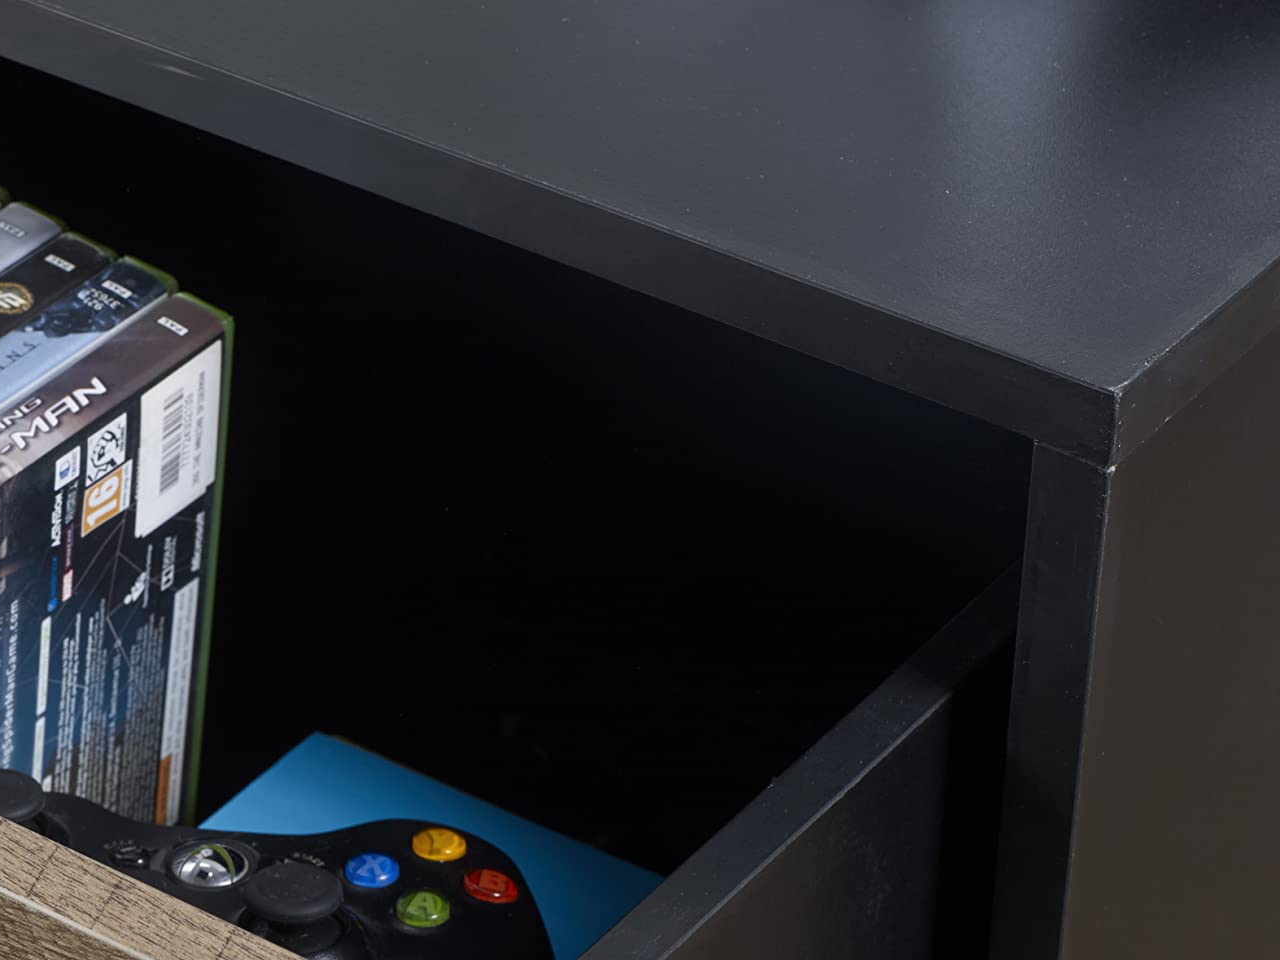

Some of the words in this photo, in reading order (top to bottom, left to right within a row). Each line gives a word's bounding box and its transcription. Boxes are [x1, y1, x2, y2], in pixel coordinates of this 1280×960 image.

[86, 475, 120, 527] 16
[2, 599, 19, 769] ingSpiderManGame.com
[356, 853, 387, 877] X
[478, 868, 508, 896] B
[406, 891, 437, 916] A
